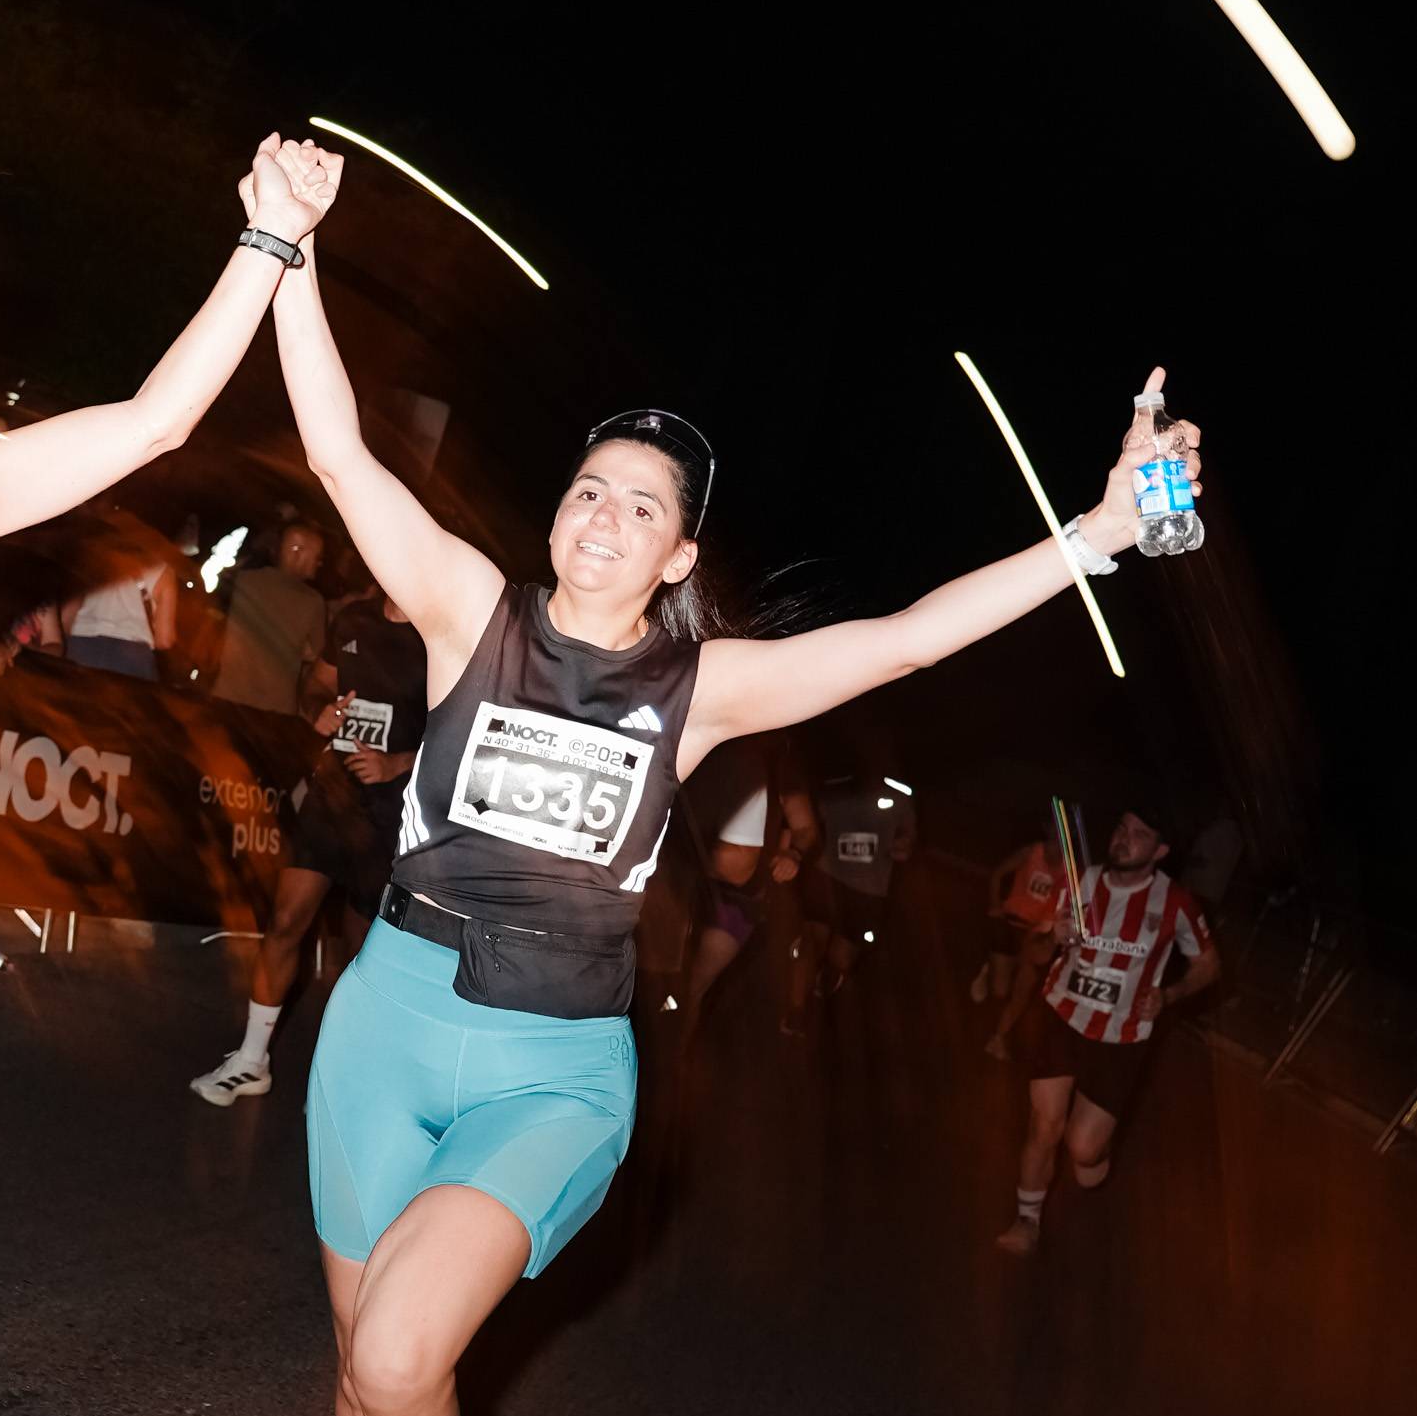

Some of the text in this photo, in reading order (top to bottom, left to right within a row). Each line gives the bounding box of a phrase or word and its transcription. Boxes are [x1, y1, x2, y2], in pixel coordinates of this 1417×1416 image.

[487, 720, 632, 770] ANOCT. ©202
[474, 755, 621, 831] 1335
[232, 816, 281, 858] plus
[1077, 976, 1112, 1001] 172
